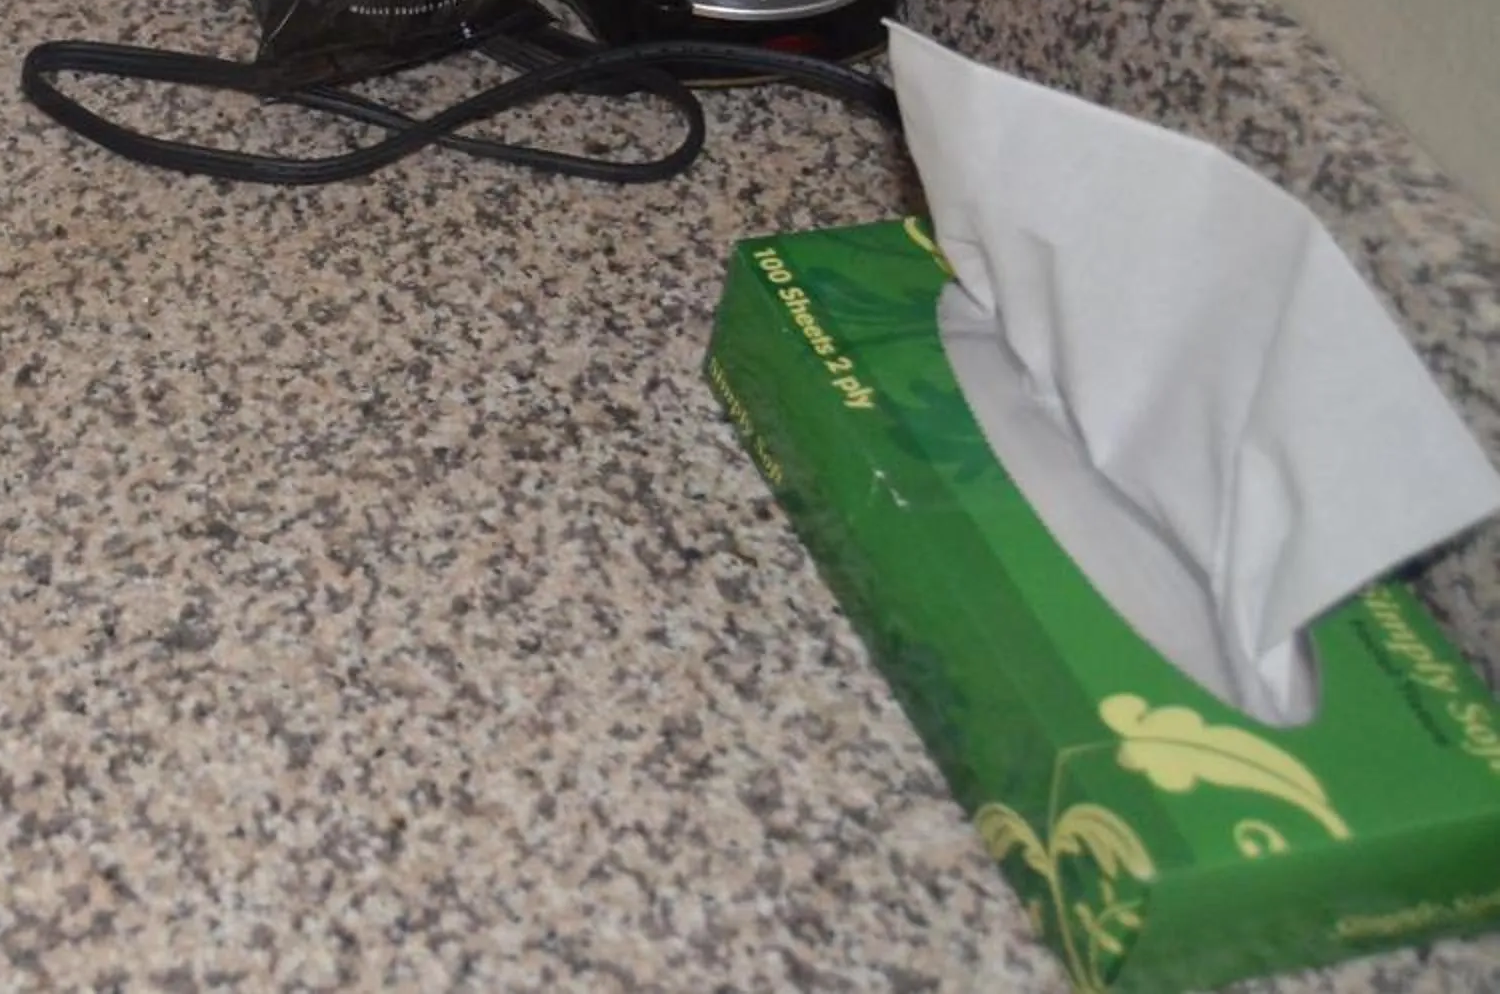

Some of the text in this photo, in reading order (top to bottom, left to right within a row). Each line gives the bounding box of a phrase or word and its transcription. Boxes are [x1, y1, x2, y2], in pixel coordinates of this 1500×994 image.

[754, 246, 875, 410] 100 Sheets 2 ply
[1364, 586, 1459, 694] imply
[1447, 699, 1500, 776] Sof
